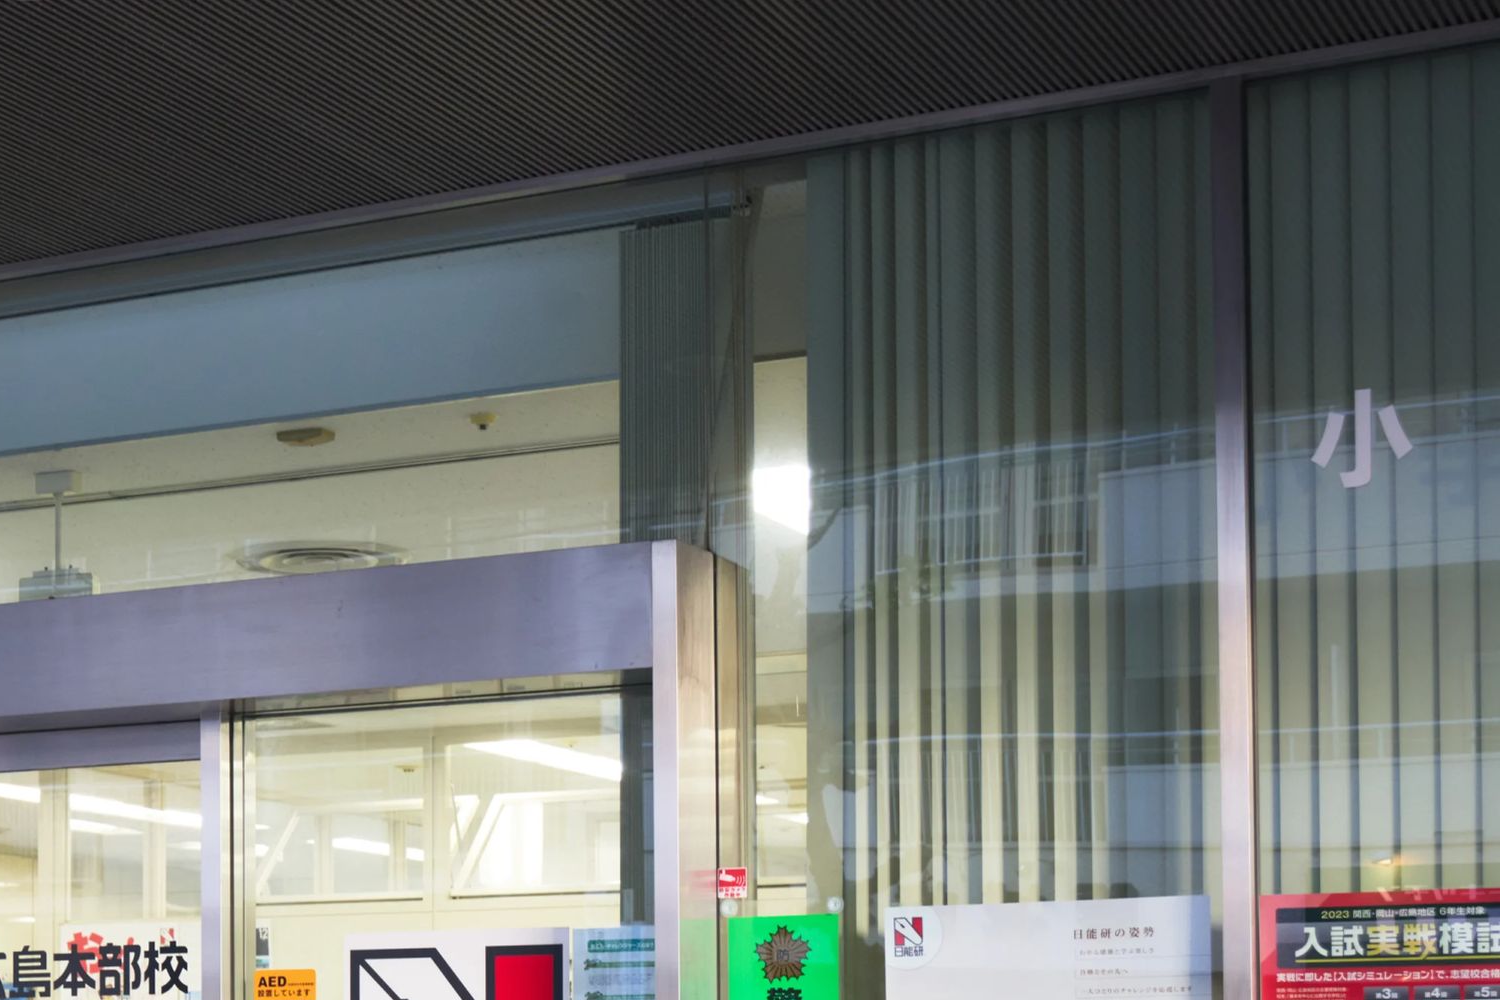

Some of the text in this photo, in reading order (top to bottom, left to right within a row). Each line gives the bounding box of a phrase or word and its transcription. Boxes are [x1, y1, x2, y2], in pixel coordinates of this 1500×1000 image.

[1311, 388, 1413, 488] 小
[1321, 910, 1350, 920] 2023
[1439, 906, 1485, 918] 6年生対象
[1073, 926, 1155, 940] 日能研の姿勢
[894, 946, 924, 957] 日能研
[258, 976, 287, 987] AED
[257, 989, 310, 998] 設置しています
